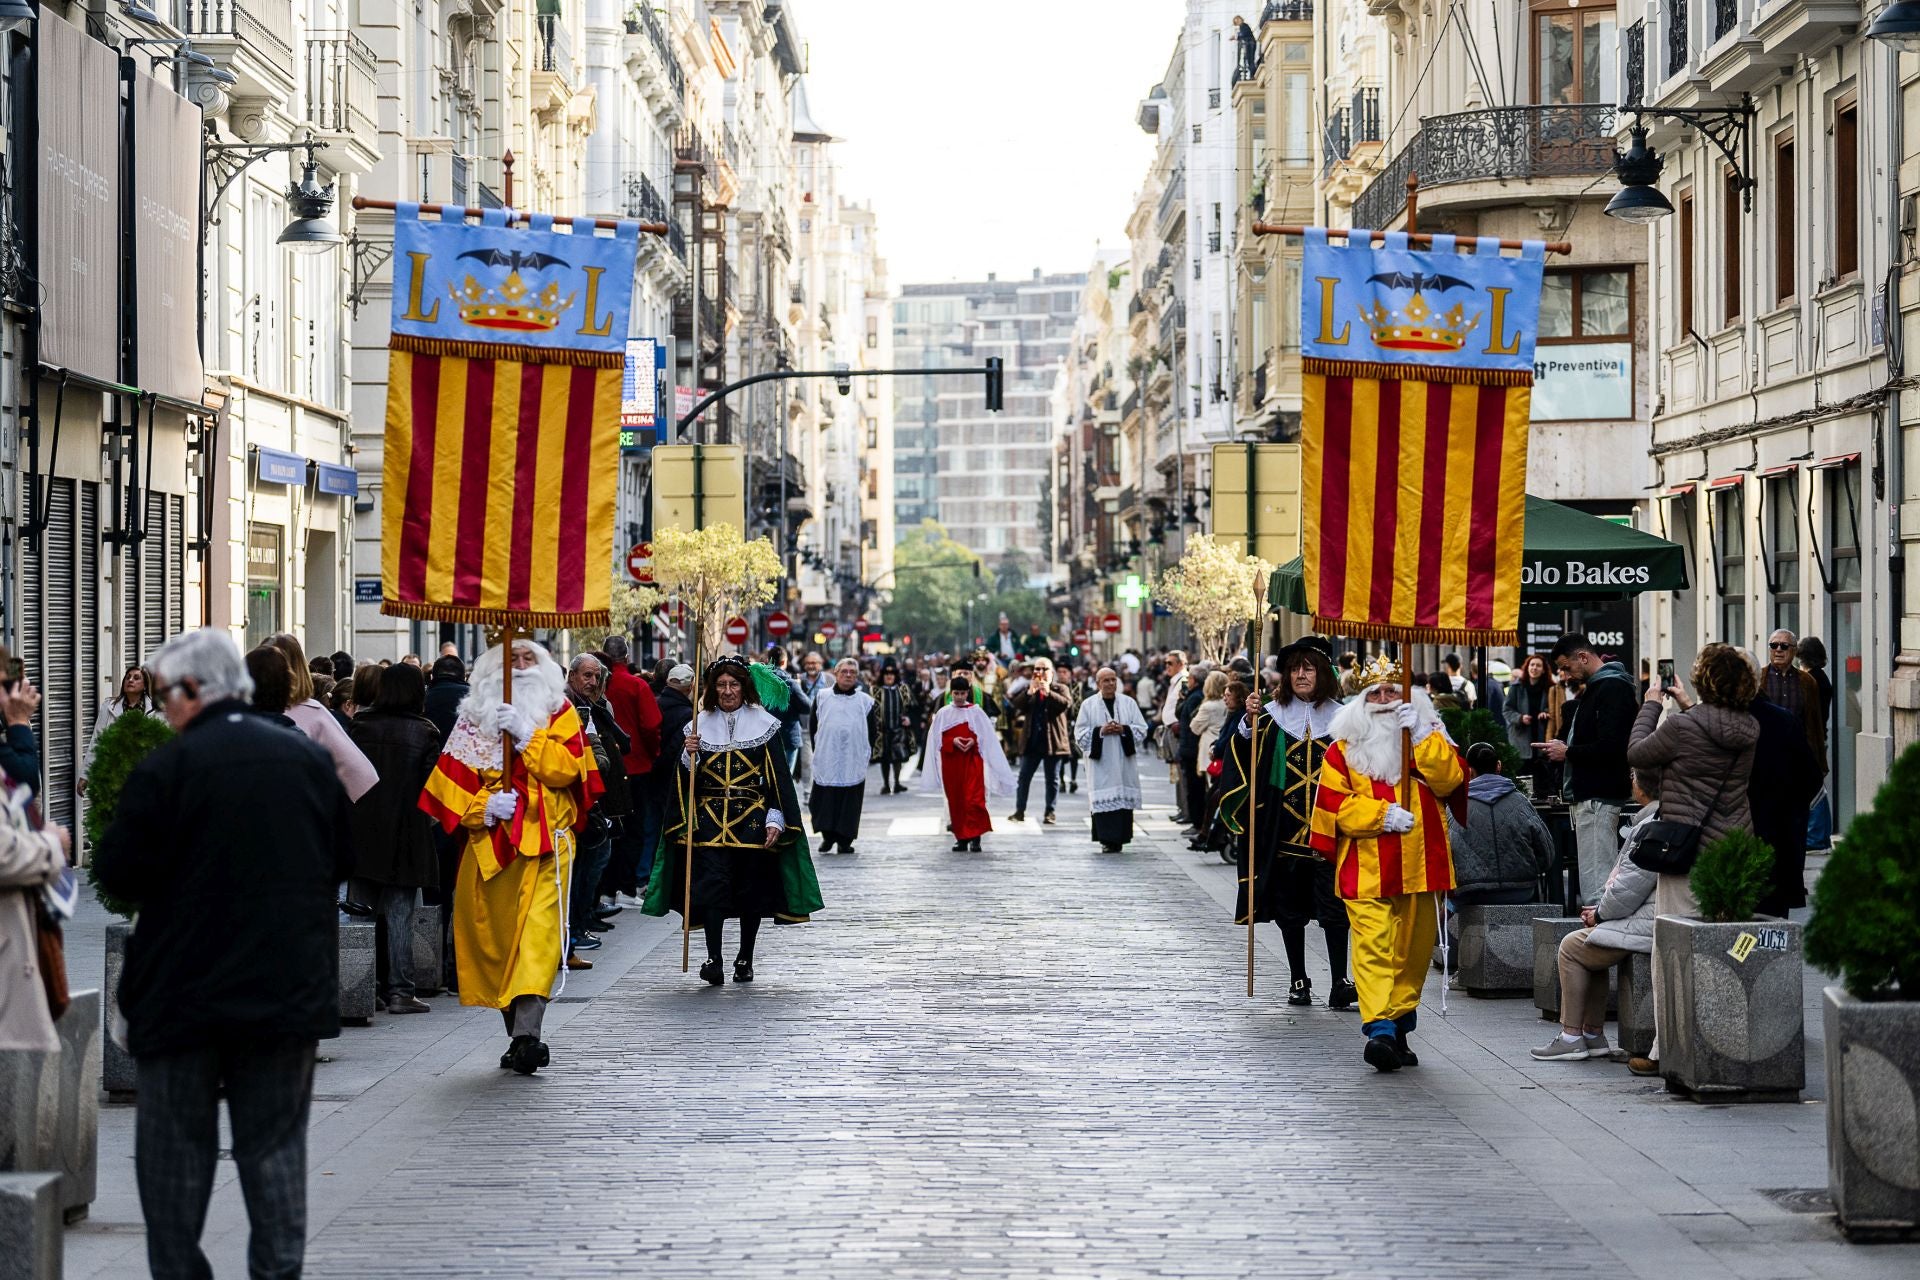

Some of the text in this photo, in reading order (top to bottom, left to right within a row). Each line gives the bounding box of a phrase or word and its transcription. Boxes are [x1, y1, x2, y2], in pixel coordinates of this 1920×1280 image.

[47, 146, 109, 202] RAFAEL TORRES
[143, 196, 191, 240] RAFAEL TORRES
[401, 251, 613, 336] L L
[1313, 277, 1521, 355] L L
[1549, 360, 1618, 371] Preventiva
[627, 414, 655, 425] REINA
[1565, 561, 1650, 585] Bakes
[1587, 631, 1624, 646] BOSS
